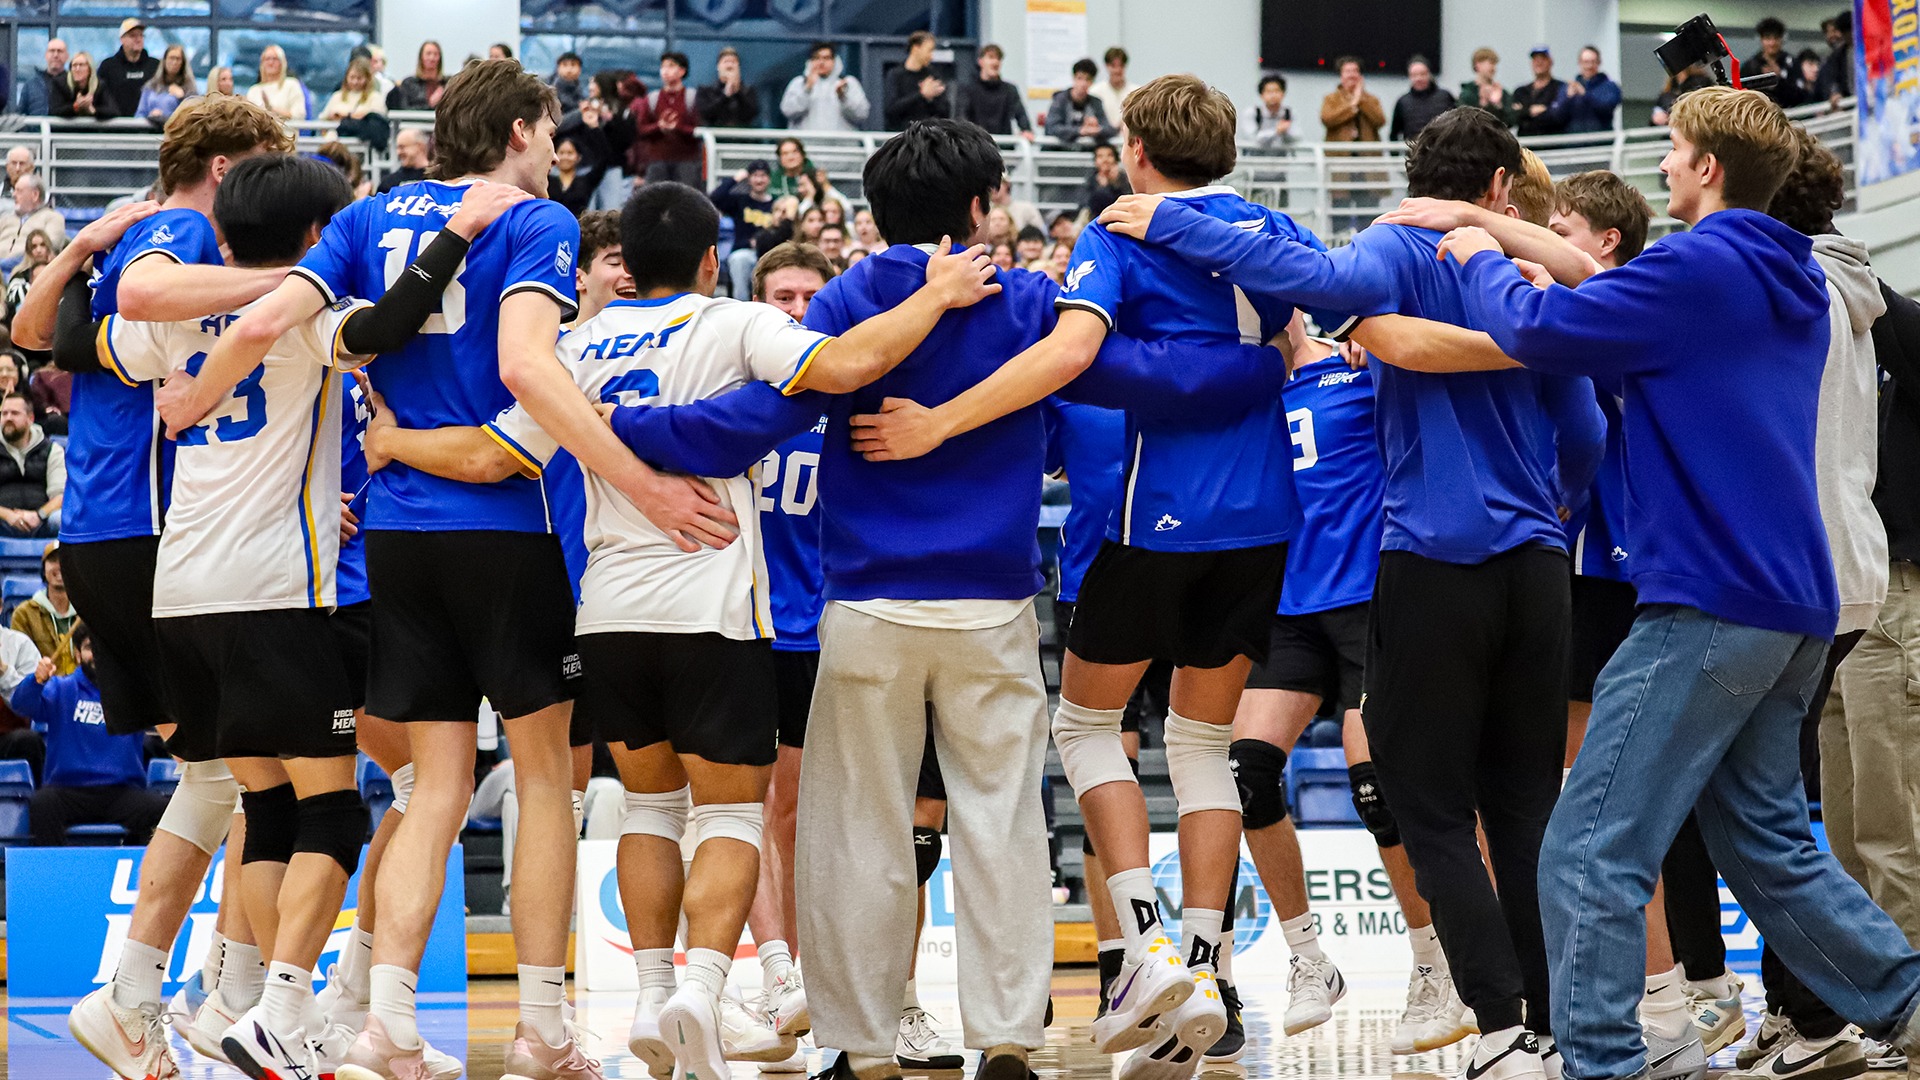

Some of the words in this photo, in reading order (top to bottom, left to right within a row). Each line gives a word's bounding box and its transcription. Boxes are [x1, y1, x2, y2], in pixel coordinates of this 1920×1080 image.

[578, 317, 692, 361] HEAT
[1317, 371, 1361, 388] HEAT
[760, 449, 820, 516] 20
[563, 660, 582, 675] HEA
[331, 716, 356, 730] HEA
[1333, 912, 1348, 936] &
[920, 939, 953, 958] ing
